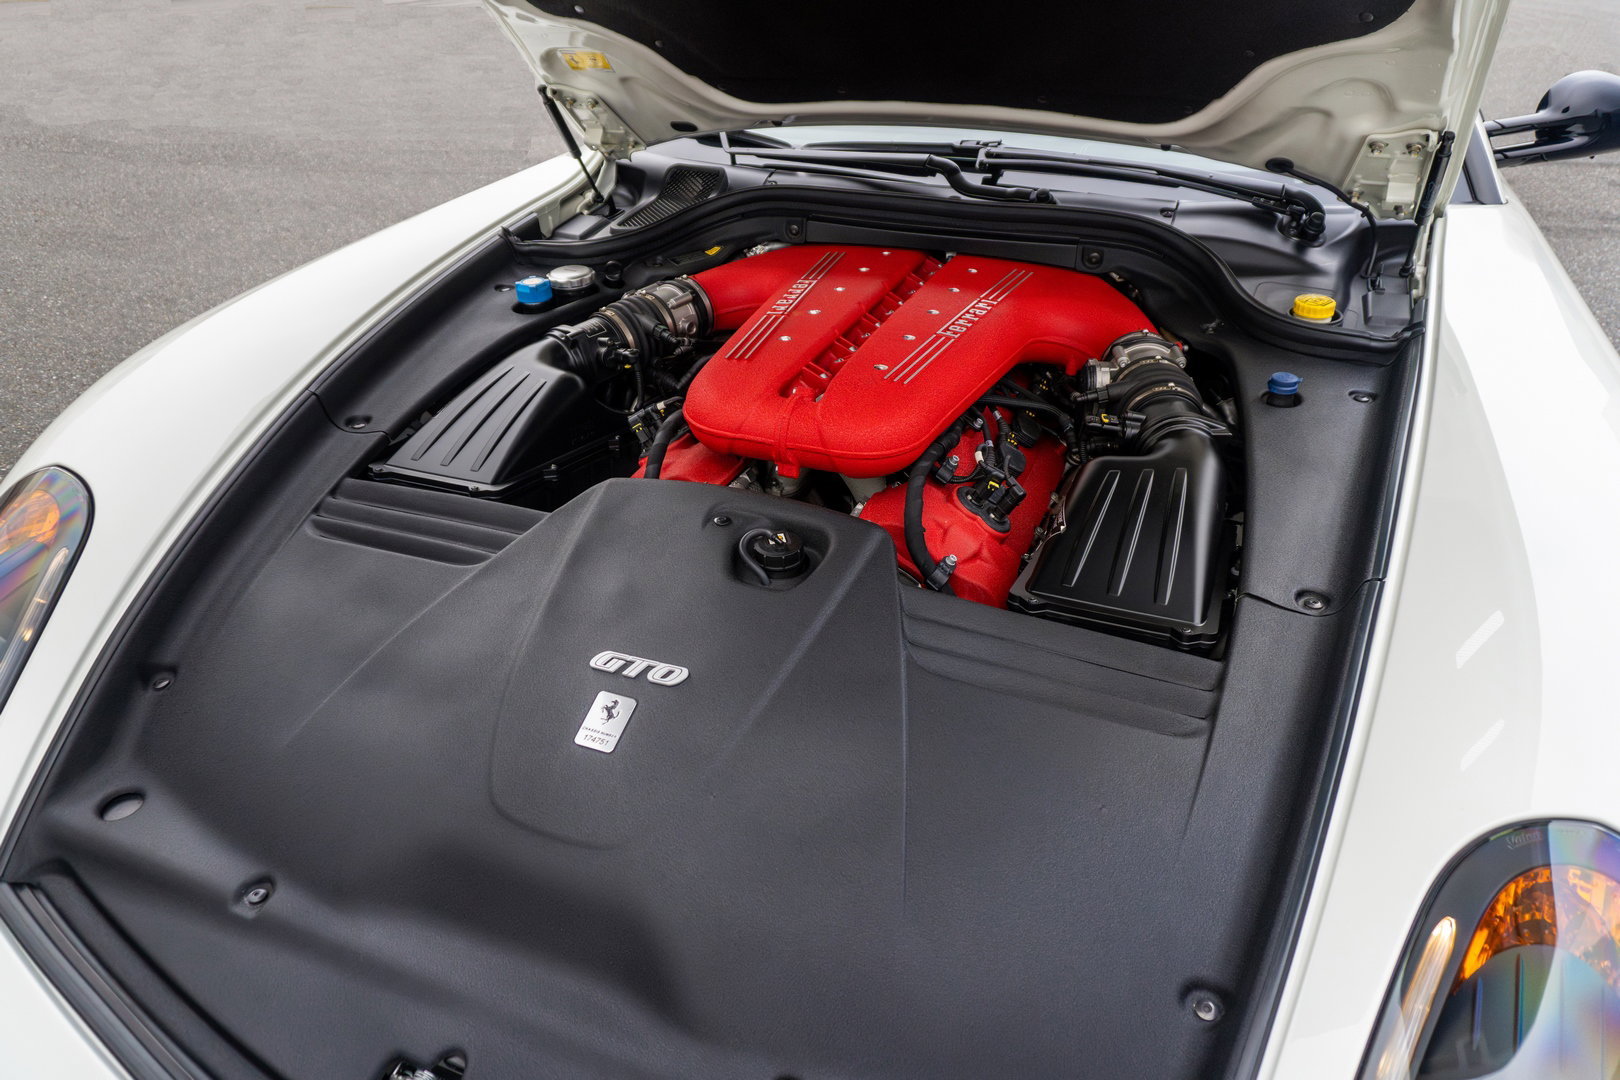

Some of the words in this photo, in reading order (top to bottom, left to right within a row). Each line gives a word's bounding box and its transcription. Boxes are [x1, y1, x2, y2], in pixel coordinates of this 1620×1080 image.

[936, 298, 998, 339] Ferrari
[589, 650, 690, 687] GTO
[583, 734, 609, 746] 174751
